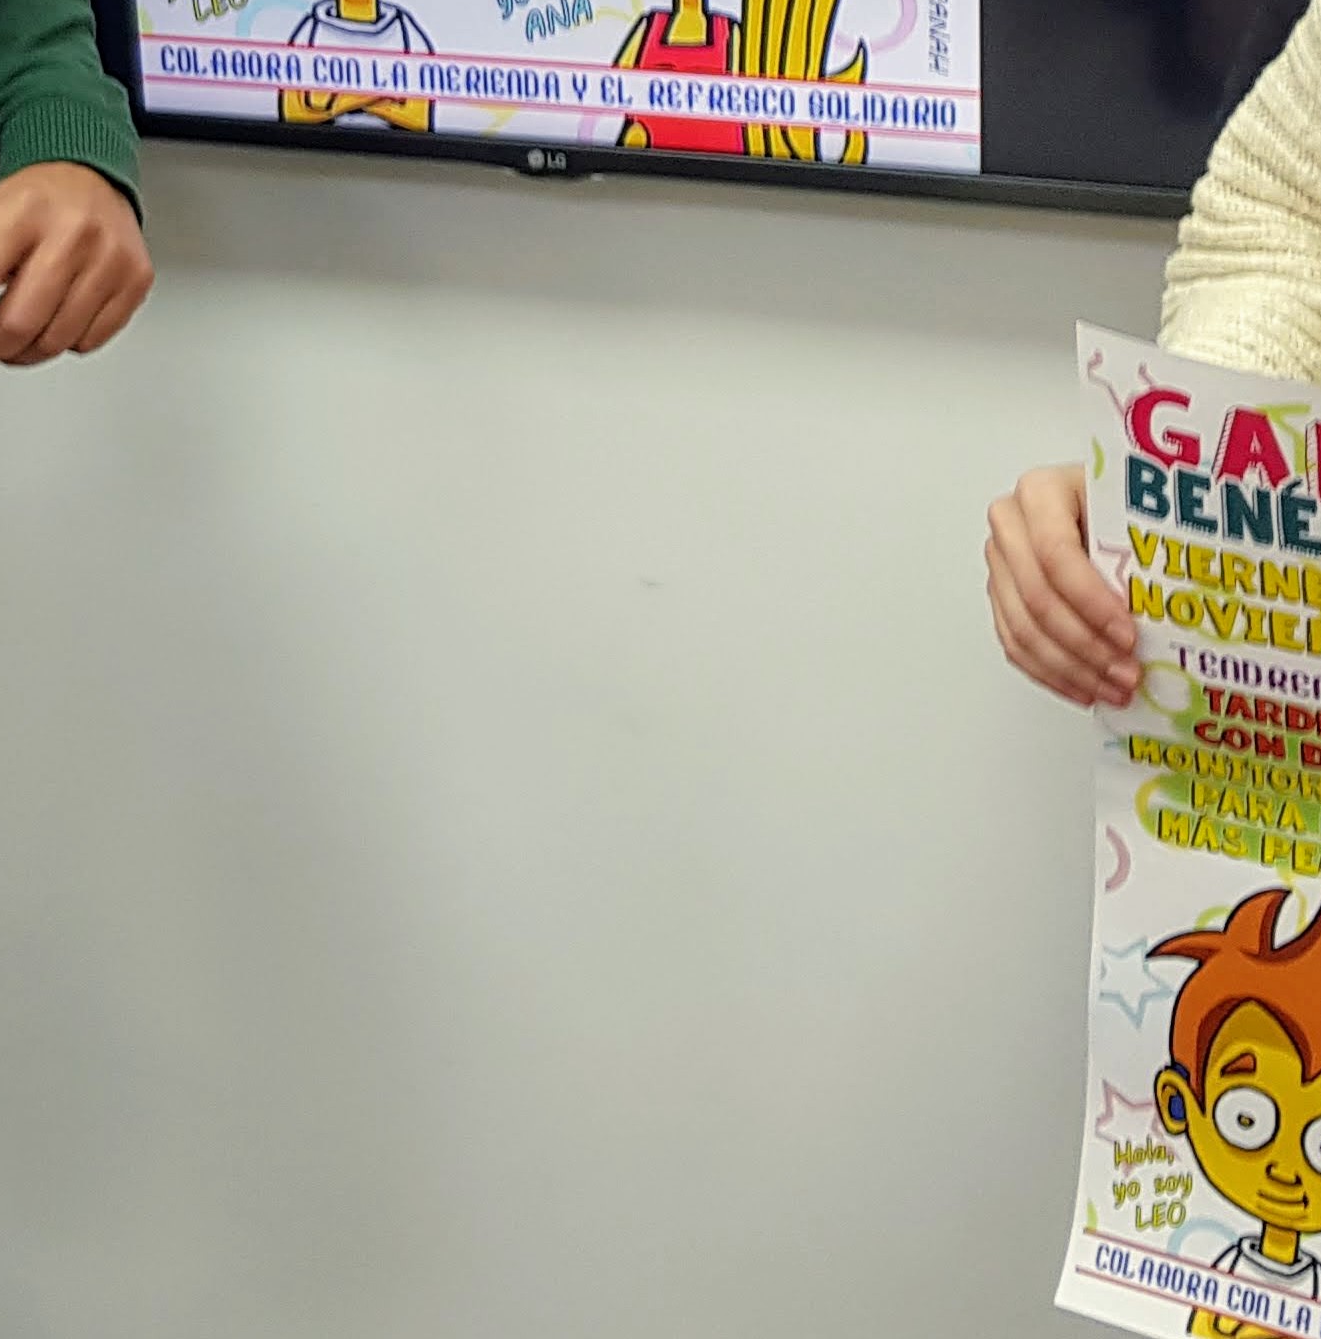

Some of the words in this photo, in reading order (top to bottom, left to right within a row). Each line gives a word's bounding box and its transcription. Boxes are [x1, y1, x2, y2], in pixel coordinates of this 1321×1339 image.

[161, 46, 301, 82] COLABORA
[314, 58, 361, 87] CON
[373, 61, 409, 91] LA
[420, 63, 561, 100] MERIENDA
[572, 72, 587, 101] Y
[601, 77, 631, 106] EL
[649, 79, 796, 118] REFRESCO
[809, 94, 956, 131] SOLIDARIO
[1193, 719, 1287, 761] CON
[1191, 780, 1305, 833] PARA
[1113, 1140, 1174, 1167] Hola,
[1113, 1181, 1140, 1208] yo
[1154, 1173, 1193, 1198] soy
[1135, 1202, 1186, 1230] LEO
[1096, 1244, 1218, 1304] COLABORA
[1228, 1287, 1271, 1318] CON
[1279, 1300, 1311, 1330] LA
